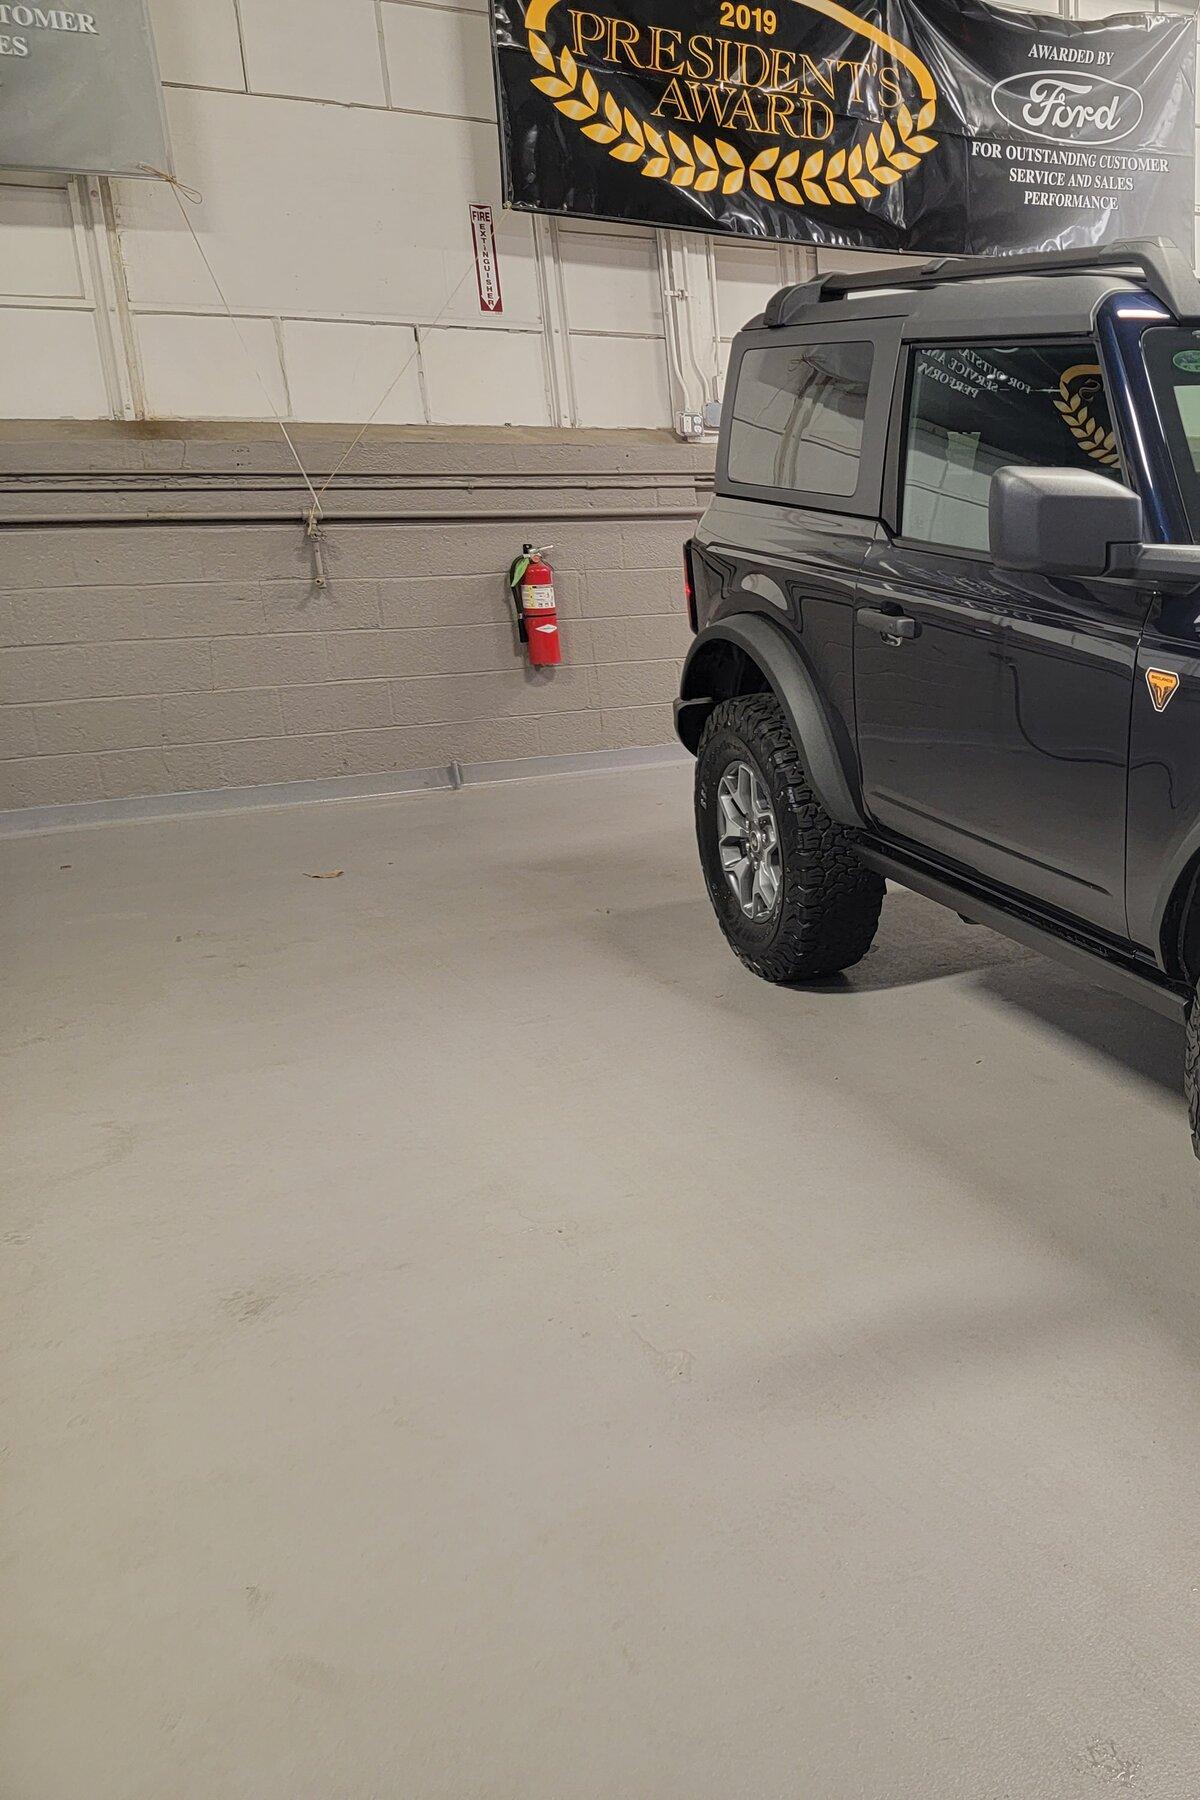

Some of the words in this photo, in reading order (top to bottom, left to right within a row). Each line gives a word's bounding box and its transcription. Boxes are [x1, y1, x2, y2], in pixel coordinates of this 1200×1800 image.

[719, 2, 777, 35] 2019
[567, 9, 902, 108] PRESIDENT'S
[1028, 44, 1095, 64] AWARDED
[1097, 51, 1115, 66] BY
[650, 78, 835, 141] AWARD
[1022, 78, 1122, 131] Ford
[971, 141, 1002, 158] FOR
[1005, 145, 1097, 168] OUTSTANDING
[1099, 154, 1170, 173] CUSTOMER
[1009, 168, 1066, 187] SERVICE
[1068, 173, 1092, 188] AND
[1094, 174, 1135, 191] SALES
[472, 210, 491, 222] FIRE
[1023, 190, 1119, 210] PERFORMANCE
[479, 223, 495, 306] EXTINGUISHER
